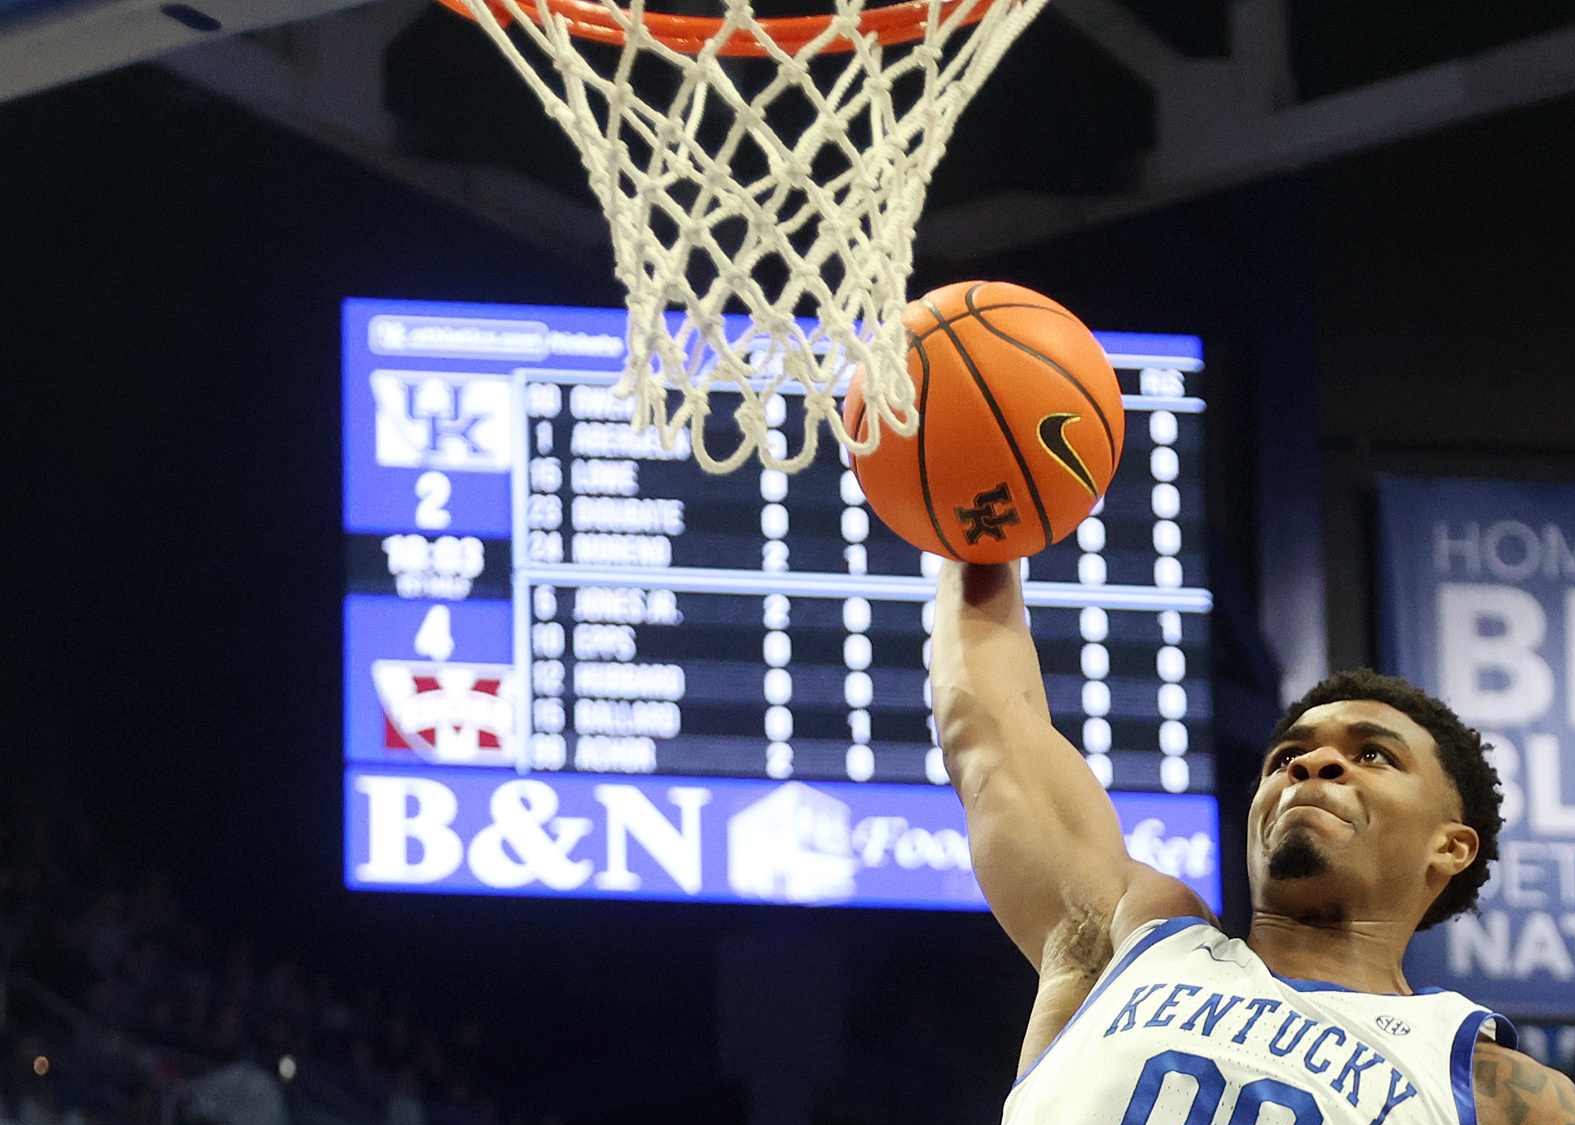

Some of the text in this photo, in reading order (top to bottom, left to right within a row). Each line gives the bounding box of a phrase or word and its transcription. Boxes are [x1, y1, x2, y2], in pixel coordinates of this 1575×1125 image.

[415, 471, 451, 530] 2
[414, 604, 454, 661] 4
[355, 775, 712, 894] B&N
